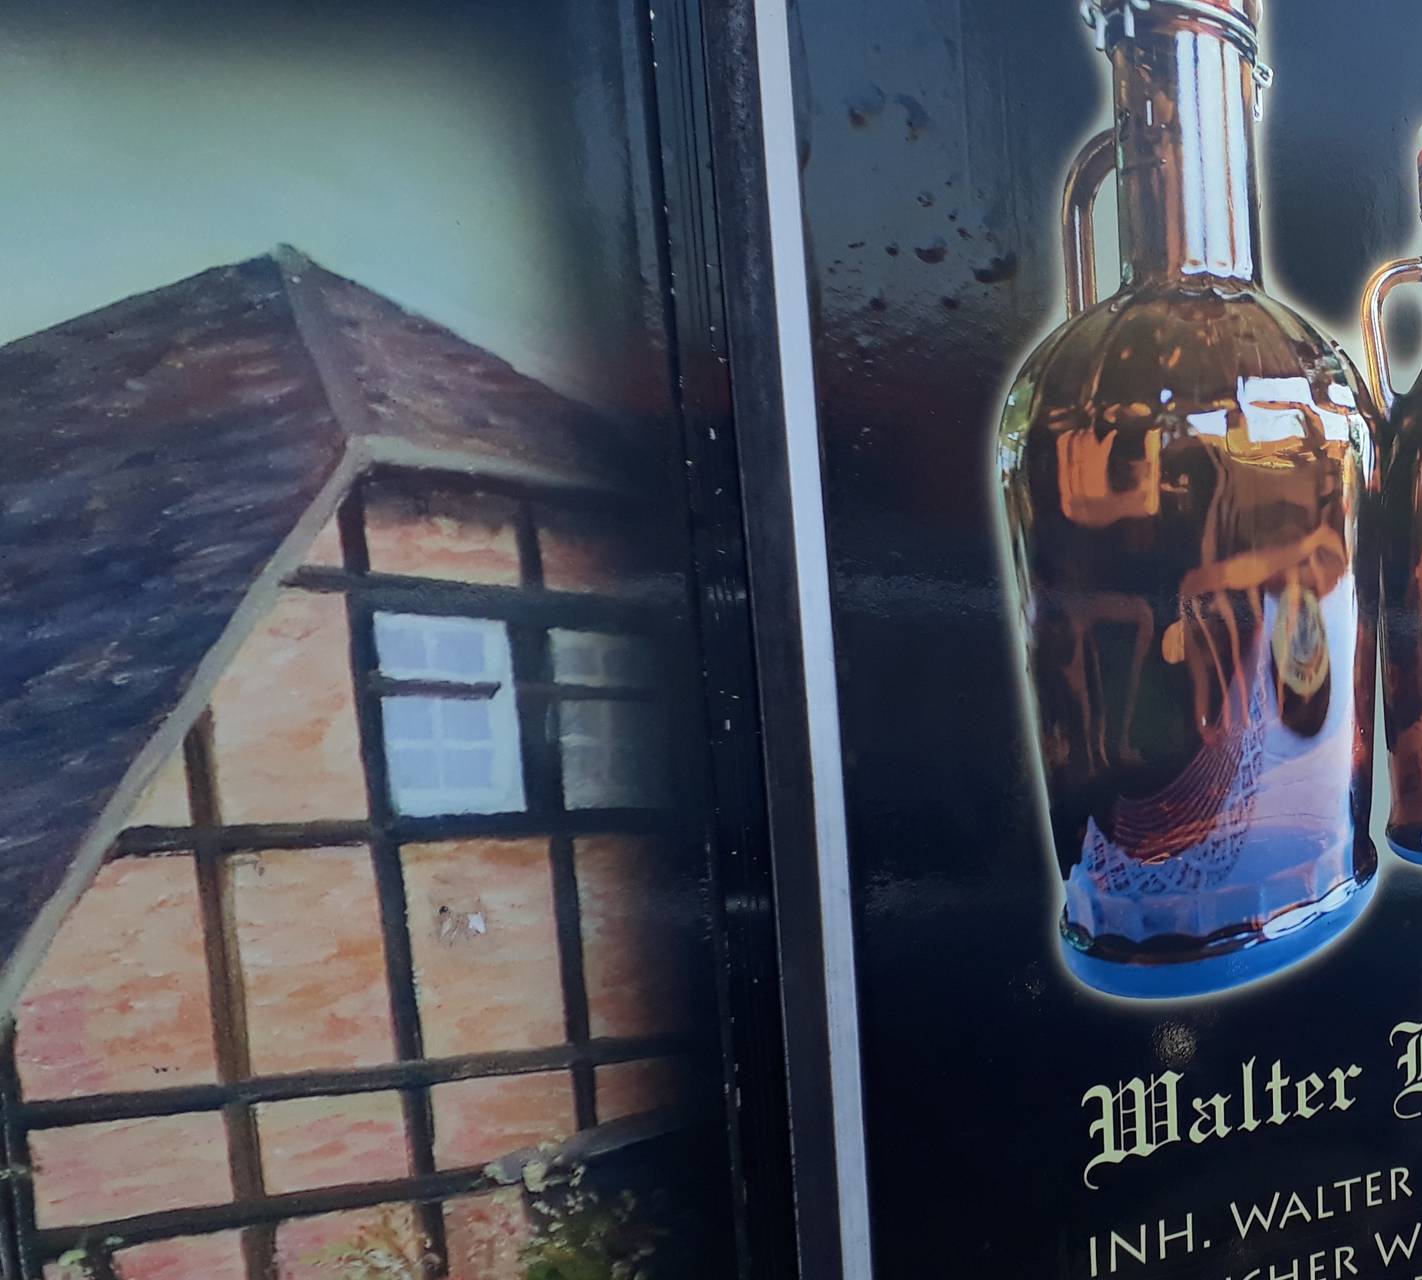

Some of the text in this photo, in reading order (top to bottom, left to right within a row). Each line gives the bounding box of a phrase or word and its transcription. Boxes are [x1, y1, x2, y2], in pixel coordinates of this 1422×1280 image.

[1081, 1055, 1363, 1189] Walter
[1089, 1213, 1211, 1277] INH.
[1230, 1167, 1413, 1240] WALTER
[1225, 1246, 1359, 1280] HER
